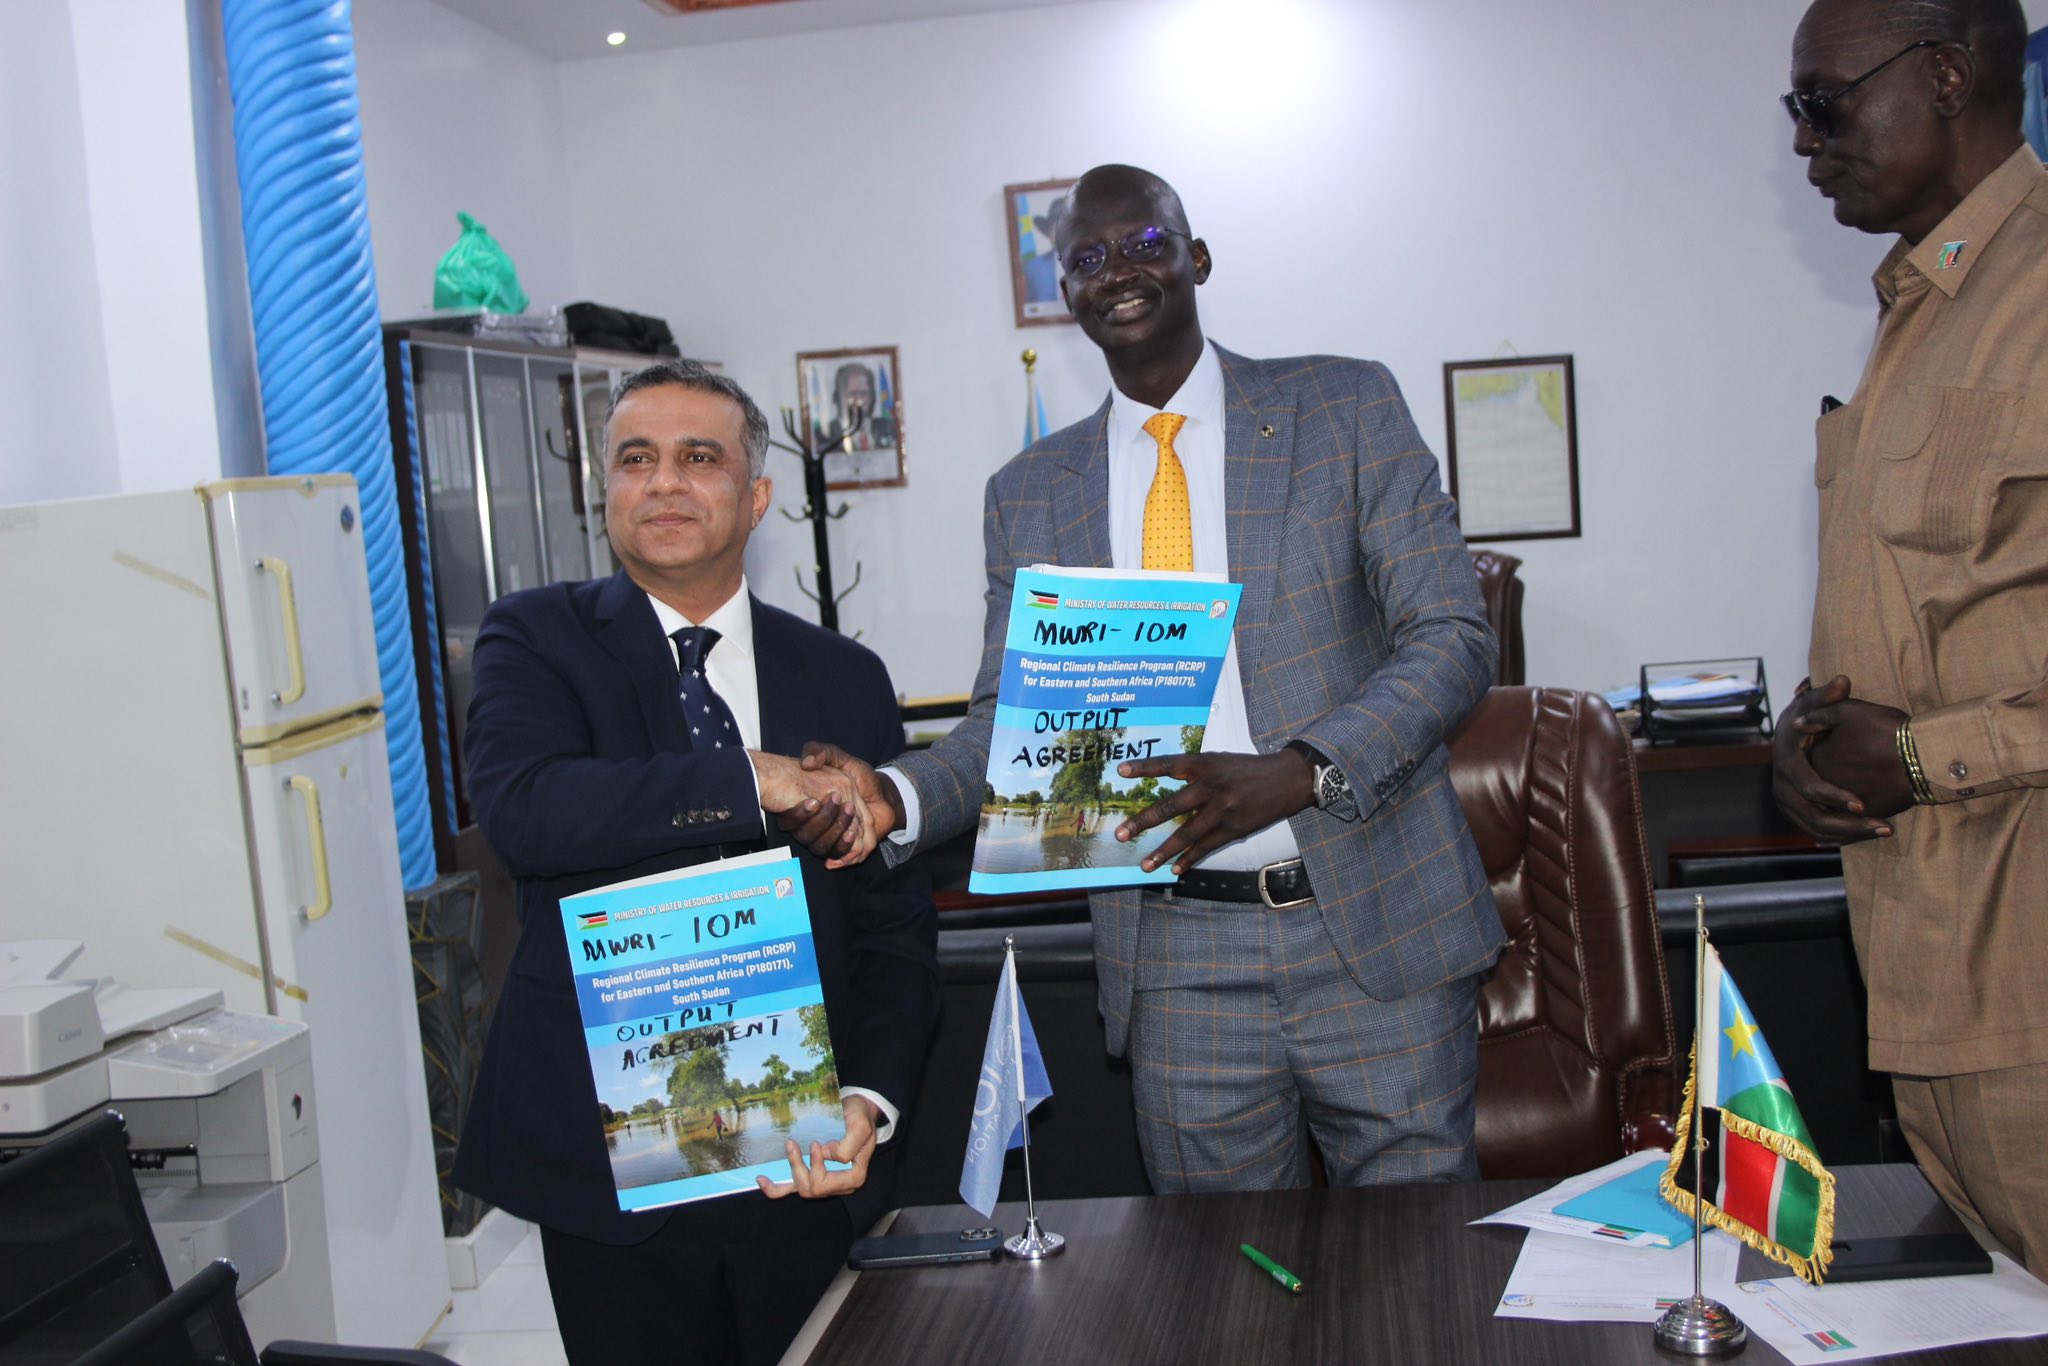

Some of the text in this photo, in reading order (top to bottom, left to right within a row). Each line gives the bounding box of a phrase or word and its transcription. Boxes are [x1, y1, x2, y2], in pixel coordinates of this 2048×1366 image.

[1064, 598, 1096, 610] MINISTRY
[1097, 600, 1106, 610] OF
[1107, 600, 1128, 611] WATER
[1128, 601, 1164, 611] RESOURCES
[1170, 601, 1206, 613] IRRIGATION
[1134, 621, 1187, 643] IOM
[1020, 657, 1206, 673] Regional Climate Resilience Program (RCRP)
[1023, 674, 1038, 686] for
[1039, 676, 1073, 688] Eastern
[1074, 677, 1091, 688] and
[1091, 676, 1127, 688] Southern
[1128, 675, 1153, 687] Africa
[1086, 691, 1136, 703] South Sudan
[1034, 708, 1129, 734] OUTPUT
[1011, 738, 1161, 768] AGREEMENT
[614, 907, 648, 921] MINISTRY
[648, 905, 657, 915] OF
[657, 900, 683, 913] WATER
[683, 893, 724, 909] RESOURCES
[730, 885, 770, 900] IRRIGATION
[693, 908, 757, 943] IOM
[592, 940, 797, 989] Regional Climate Resilience Program (RCRP)
[600, 957, 794, 1003] for Eastern and Southern Africa (P180171),
[672, 986, 731, 1005] South Sudan
[616, 1000, 738, 1042] OUTPUT
[622, 1013, 785, 1071] AGREEMENT
